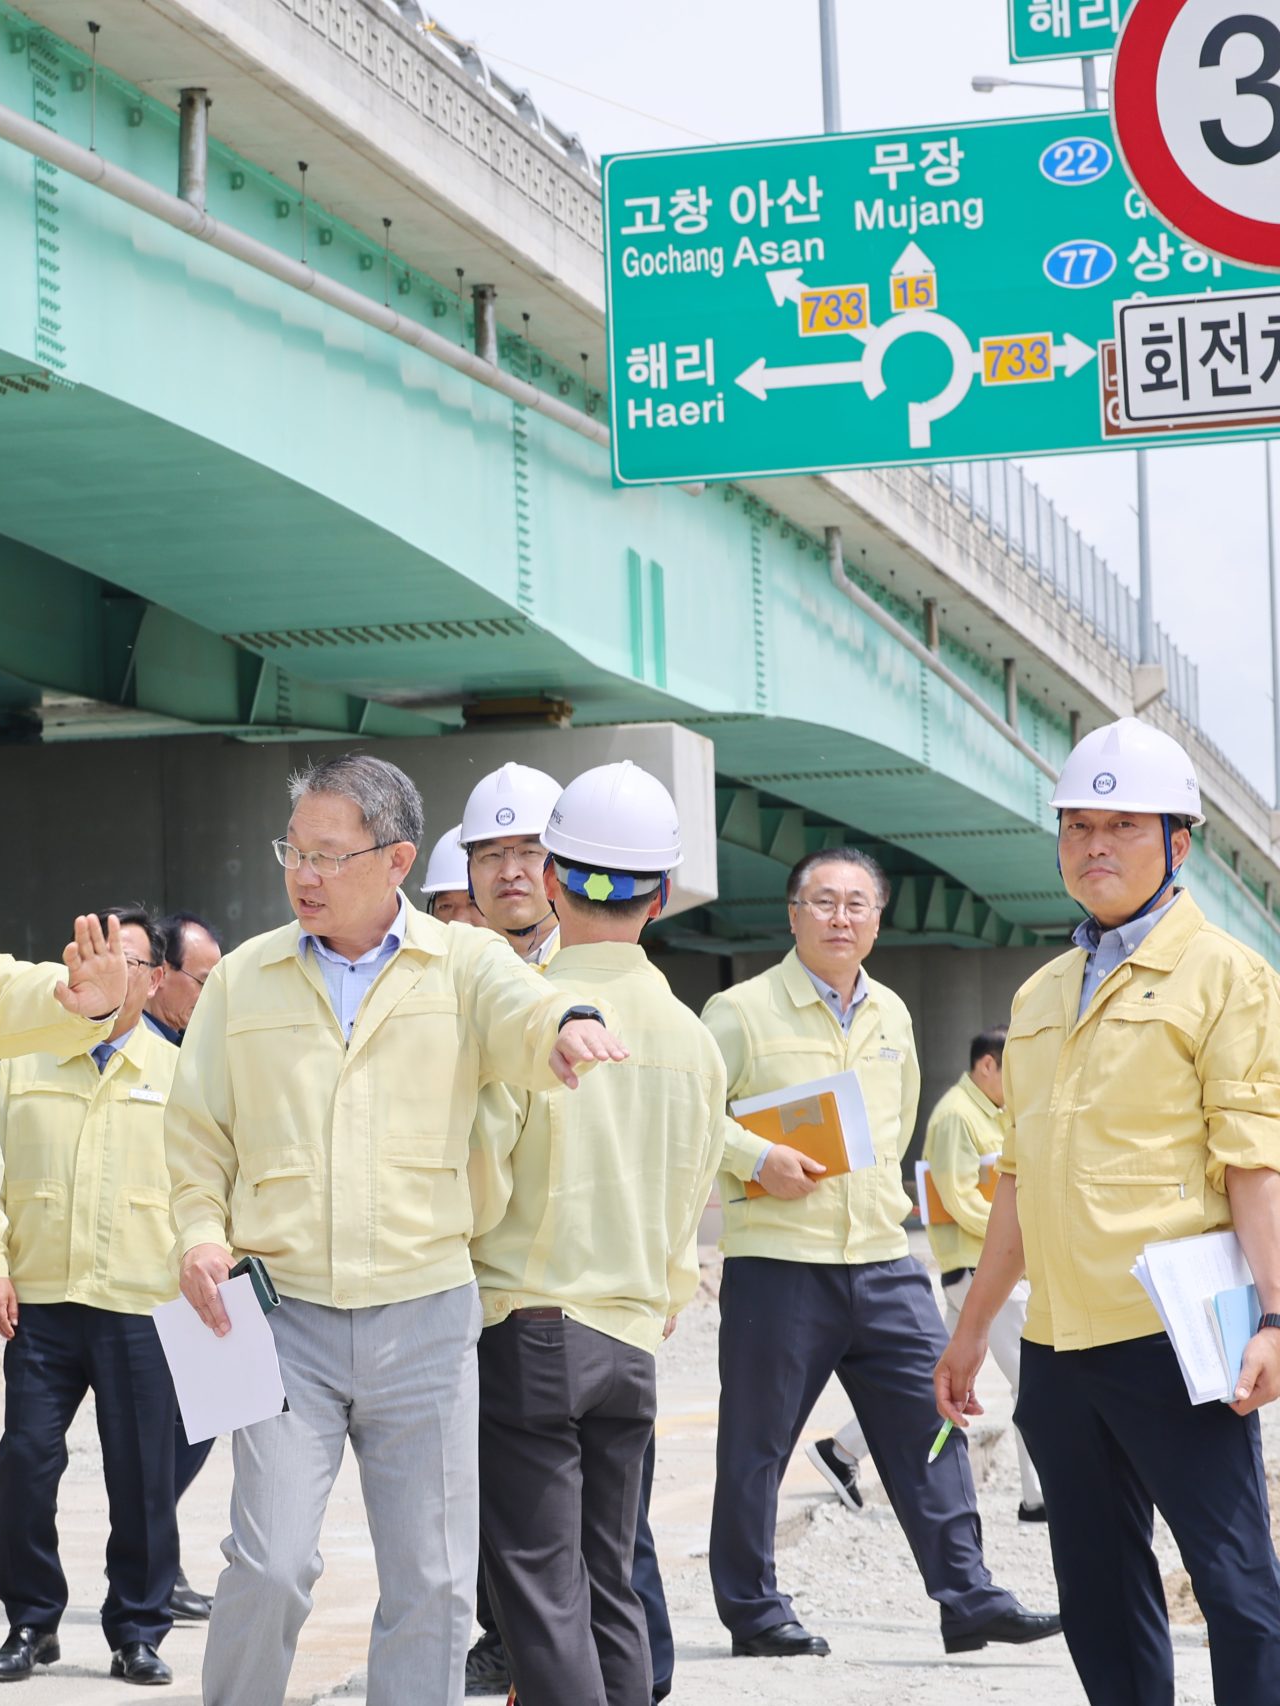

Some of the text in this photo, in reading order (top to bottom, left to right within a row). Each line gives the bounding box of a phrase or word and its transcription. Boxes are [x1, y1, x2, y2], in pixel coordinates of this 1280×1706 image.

[1199, 14, 1280, 165] 3
[869, 137, 965, 190] 무장
[1054, 143, 1099, 178] 22
[621, 175, 823, 235] 고창 아산
[854, 195, 984, 235] Mujang
[622, 236, 825, 278] Gochang Asan
[1058, 248, 1098, 283] 77
[804, 292, 864, 329] 733
[897, 279, 931, 307] 15
[626, 338, 715, 389] 해리
[986, 340, 1049, 378] 733
[628, 392, 725, 429] Haeri
